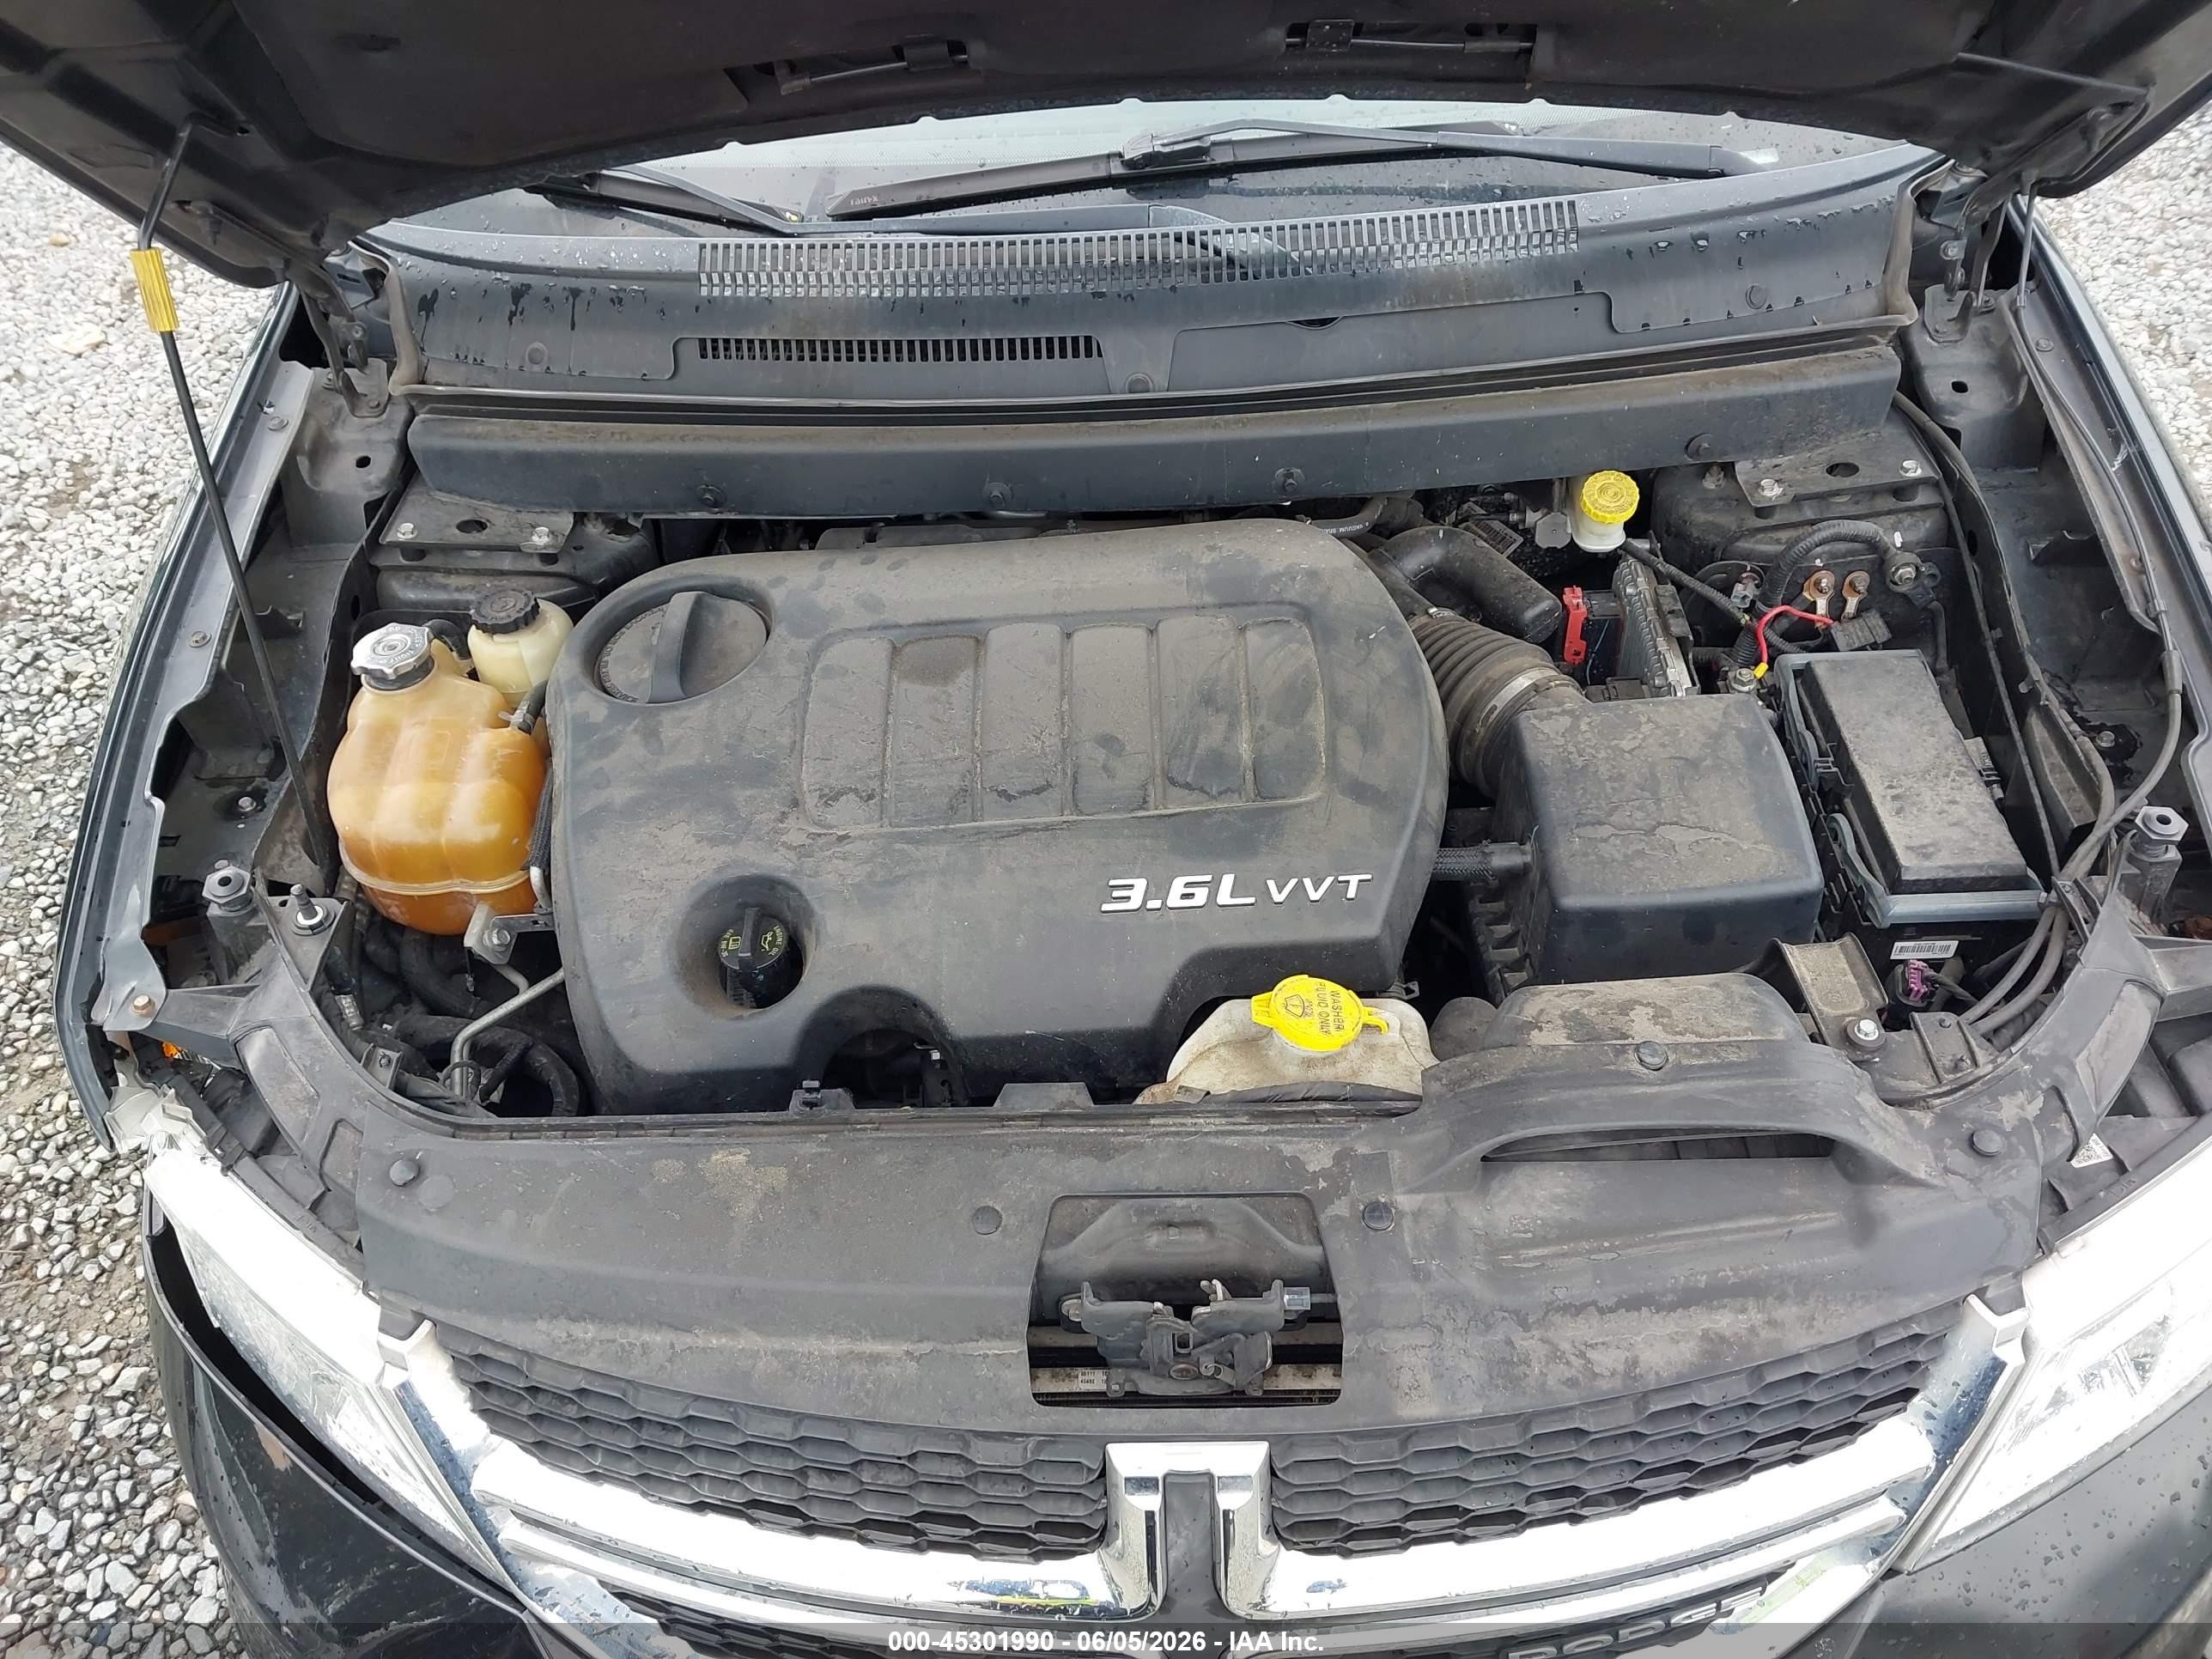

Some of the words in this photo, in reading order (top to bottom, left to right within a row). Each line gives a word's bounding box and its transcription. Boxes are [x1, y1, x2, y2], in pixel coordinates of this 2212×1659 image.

[1100, 873, 1256, 914] 3.6L
[1266, 874, 1373, 904] VVT
[769, 947, 779, 956] OIL
[1315, 981, 1328, 1009] FLUID
[1318, 1010, 1332, 1036] ONLY
[1330, 990, 1345, 1032] WASHER
